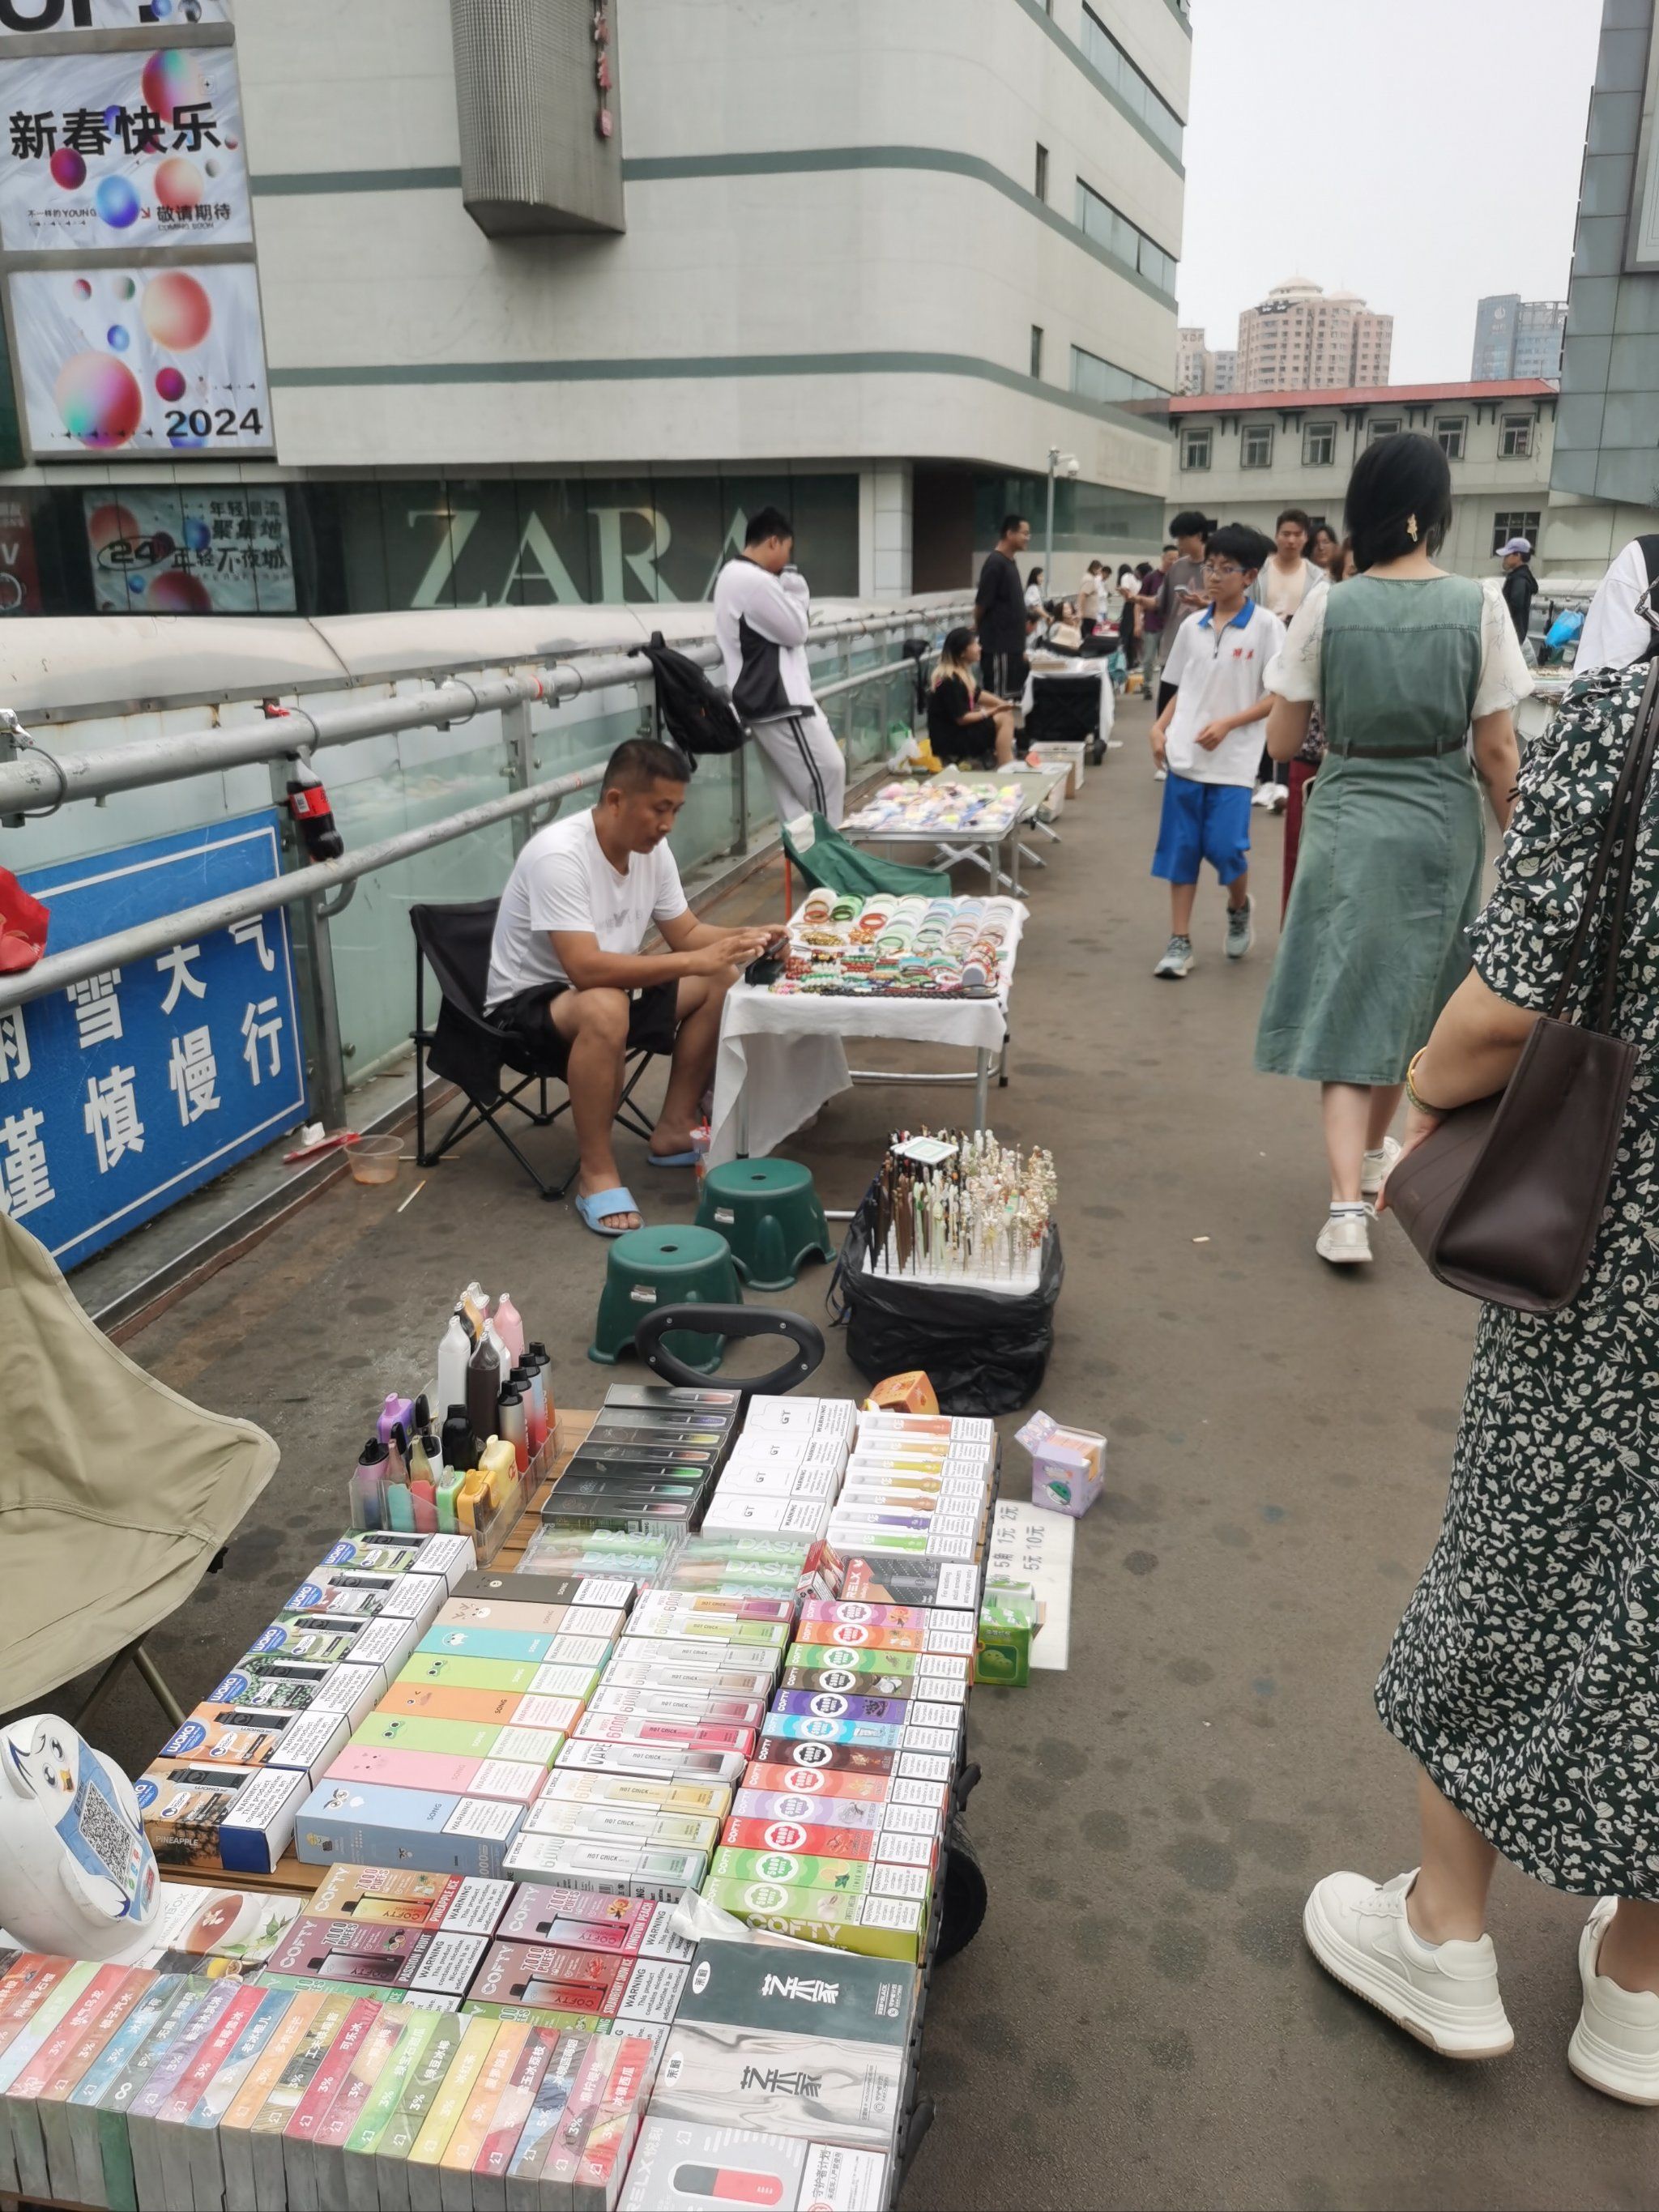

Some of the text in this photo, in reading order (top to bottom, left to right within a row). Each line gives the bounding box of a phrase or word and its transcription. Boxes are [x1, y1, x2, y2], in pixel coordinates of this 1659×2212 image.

[9, 102, 221, 160] 新春快乐
[156, 204, 231, 222] 敬请期待
[164, 407, 263, 438] 2024
[110, 542, 158, 565] 24
[782, 1409, 791, 1425] GT
[817, 1404, 828, 1433] WARNING
[770, 1444, 780, 1455] GT
[756, 1471, 766, 1483] GT
[744, 1506, 755, 1517] GT
[557, 1582, 569, 1595] SONG
[847, 1571, 862, 1599] RELX
[528, 1639, 541, 1653] SONG
[791, 1644, 804, 1664] COFTY
[787, 1667, 800, 1686] COFTY
[494, 1698, 508, 1715] SONG
[778, 1690, 791, 1711] COFTY
[170, 1725, 196, 1754] waka
[758, 1738, 772, 1760] COFTY
[587, 1742, 612, 1766] VAPE
[451, 1763, 466, 1781] SONG
[748, 1762, 764, 1786] COFTY
[426, 1802, 443, 1822] SONG
[738, 1789, 751, 1814] COFTY
[450, 1800, 473, 1831] WARNING
[155, 1835, 199, 1848] PINEAPPLE
[727, 1818, 743, 1843] COFTY
[717, 1848, 733, 1874] COFTY
[315, 1866, 350, 1912] COFTY
[370, 1869, 390, 1891] PUFFS
[429, 1878, 460, 1923] PINEAPPLE ICE
[448, 1885, 472, 1920] WARNING
[509, 1886, 539, 1932] COFTY
[562, 1890, 581, 1912] PUFFS
[638, 1903, 654, 1922] PEACH
[339, 1923, 358, 1946] PUFFS
[646, 1910, 667, 1946] WARNING
[746, 1912, 842, 1941] COFTY
[279, 1920, 348, 1969] COFTY 7000
[399, 1933, 433, 1984] PASSION FRUIT
[418, 1941, 445, 1979] WARNING
[481, 1944, 545, 1995] COFTY 7000
[538, 1949, 557, 1974] PUFFS
[603, 1984, 622, 2014] STRAWBERRY
[624, 1968, 646, 2009] WARNING
[638, 1972, 655, 2007] This product
[645, 1966, 667, 2016] contains nicotine.
[655, 1988, 668, 2011] Nicotine
[663, 1966, 685, 2020] addictive chemical.
[339, 2022, 363, 2052] 可乐冰
[78, 2041, 96, 2059] 3%
[164, 2053, 184, 2072] 3%
[288, 2072, 305, 2090] 3%
[347, 2080, 365, 2099] 3%
[379, 2089, 395, 2108] 3%
[567, 2116, 584, 2137] 3%
